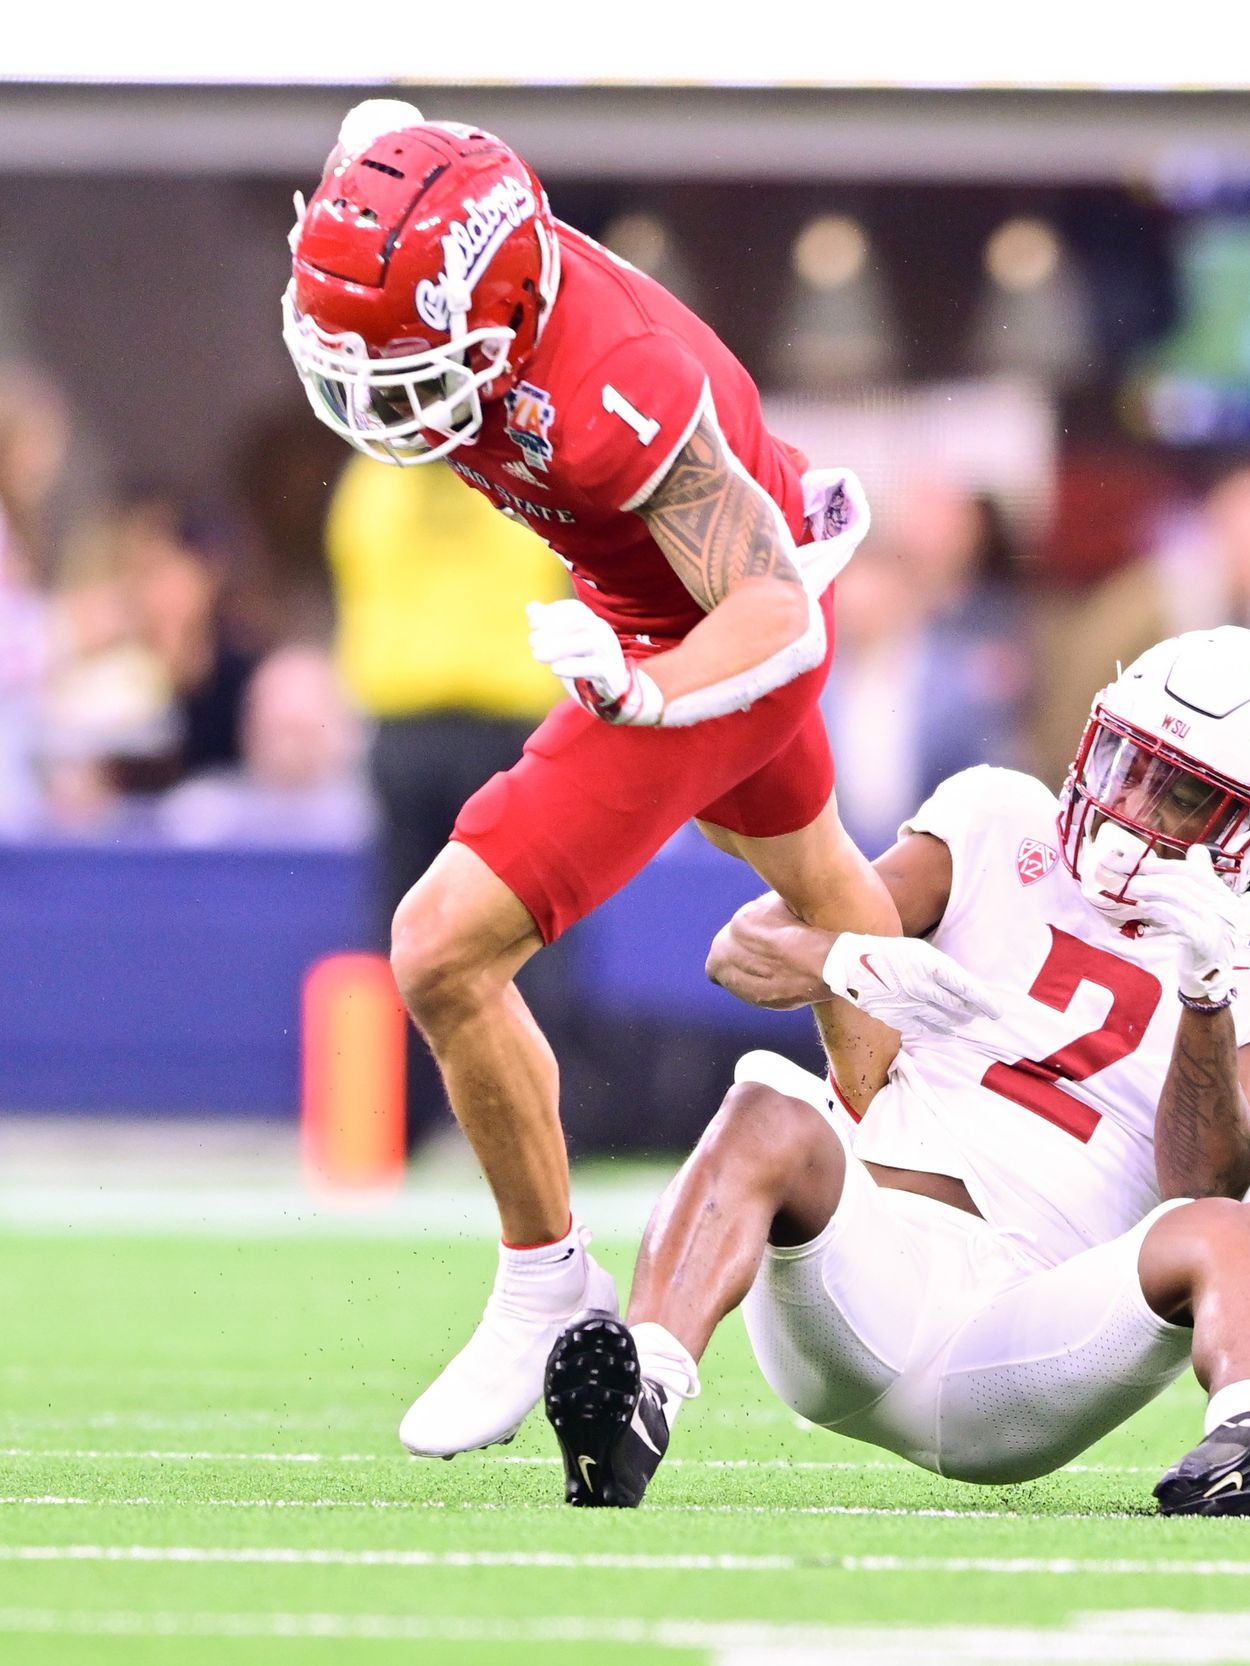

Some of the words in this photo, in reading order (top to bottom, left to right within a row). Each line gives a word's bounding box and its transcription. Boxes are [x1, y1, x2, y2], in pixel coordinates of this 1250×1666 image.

[415, 175, 536, 331] Bldogs
[601, 383, 662, 447] 1
[1161, 713, 1192, 739] WSU
[1018, 839, 1058, 873] PAC
[1020, 858, 1043, 878] 12
[981, 923, 1163, 1144] 2
